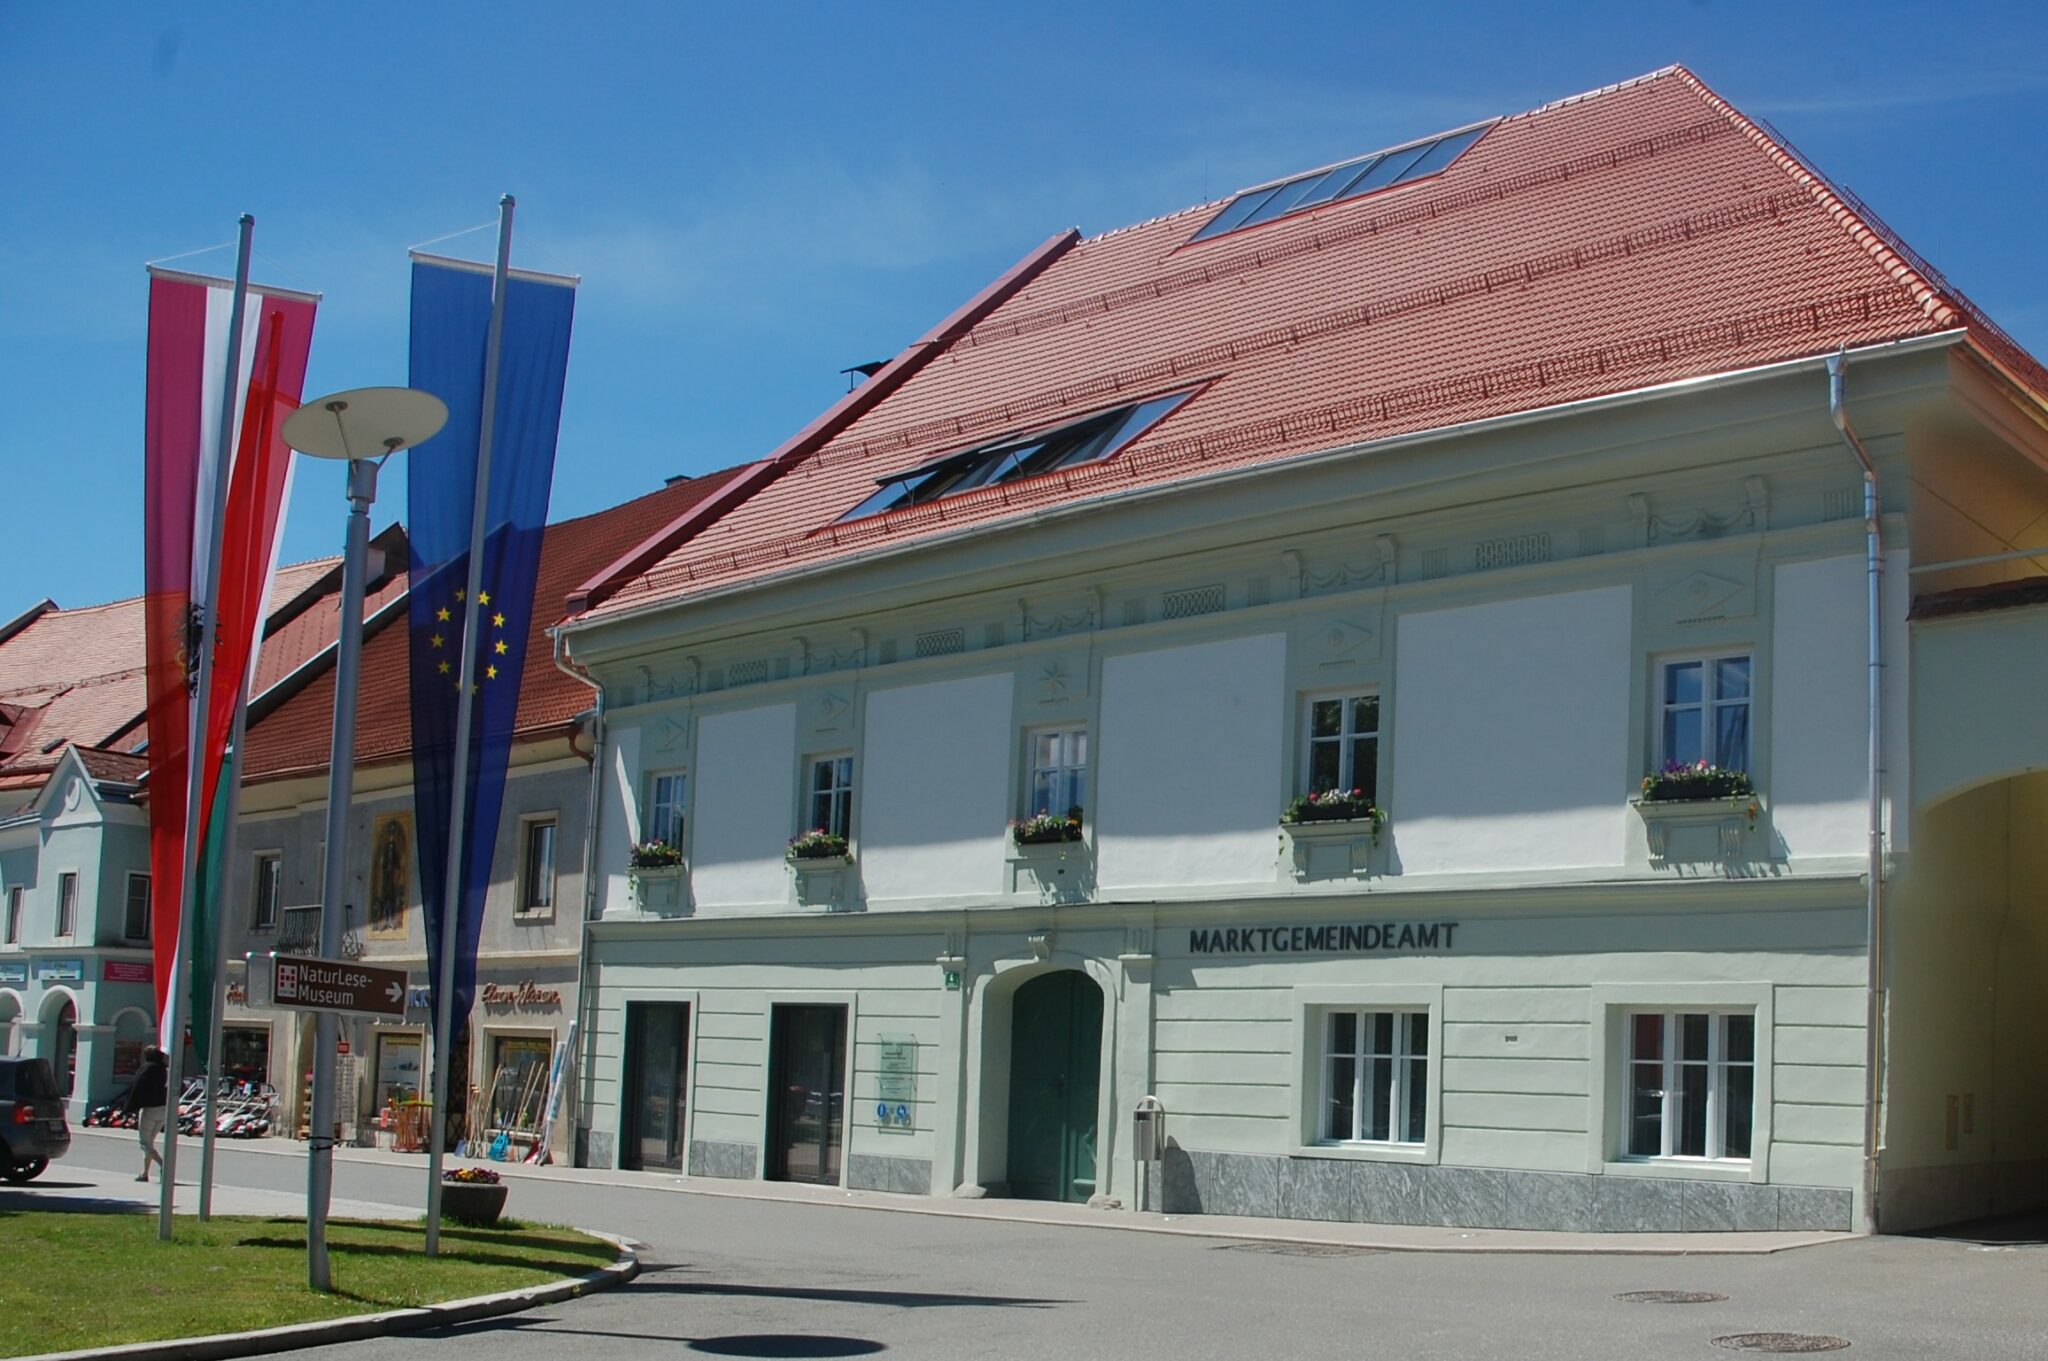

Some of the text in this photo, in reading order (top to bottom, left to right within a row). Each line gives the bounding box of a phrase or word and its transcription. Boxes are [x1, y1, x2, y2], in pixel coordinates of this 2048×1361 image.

[1189, 923, 1459, 953] MARKTGEMEINDEAMT
[299, 964, 373, 989] NaturLese-
[298, 984, 354, 1006] Museum
